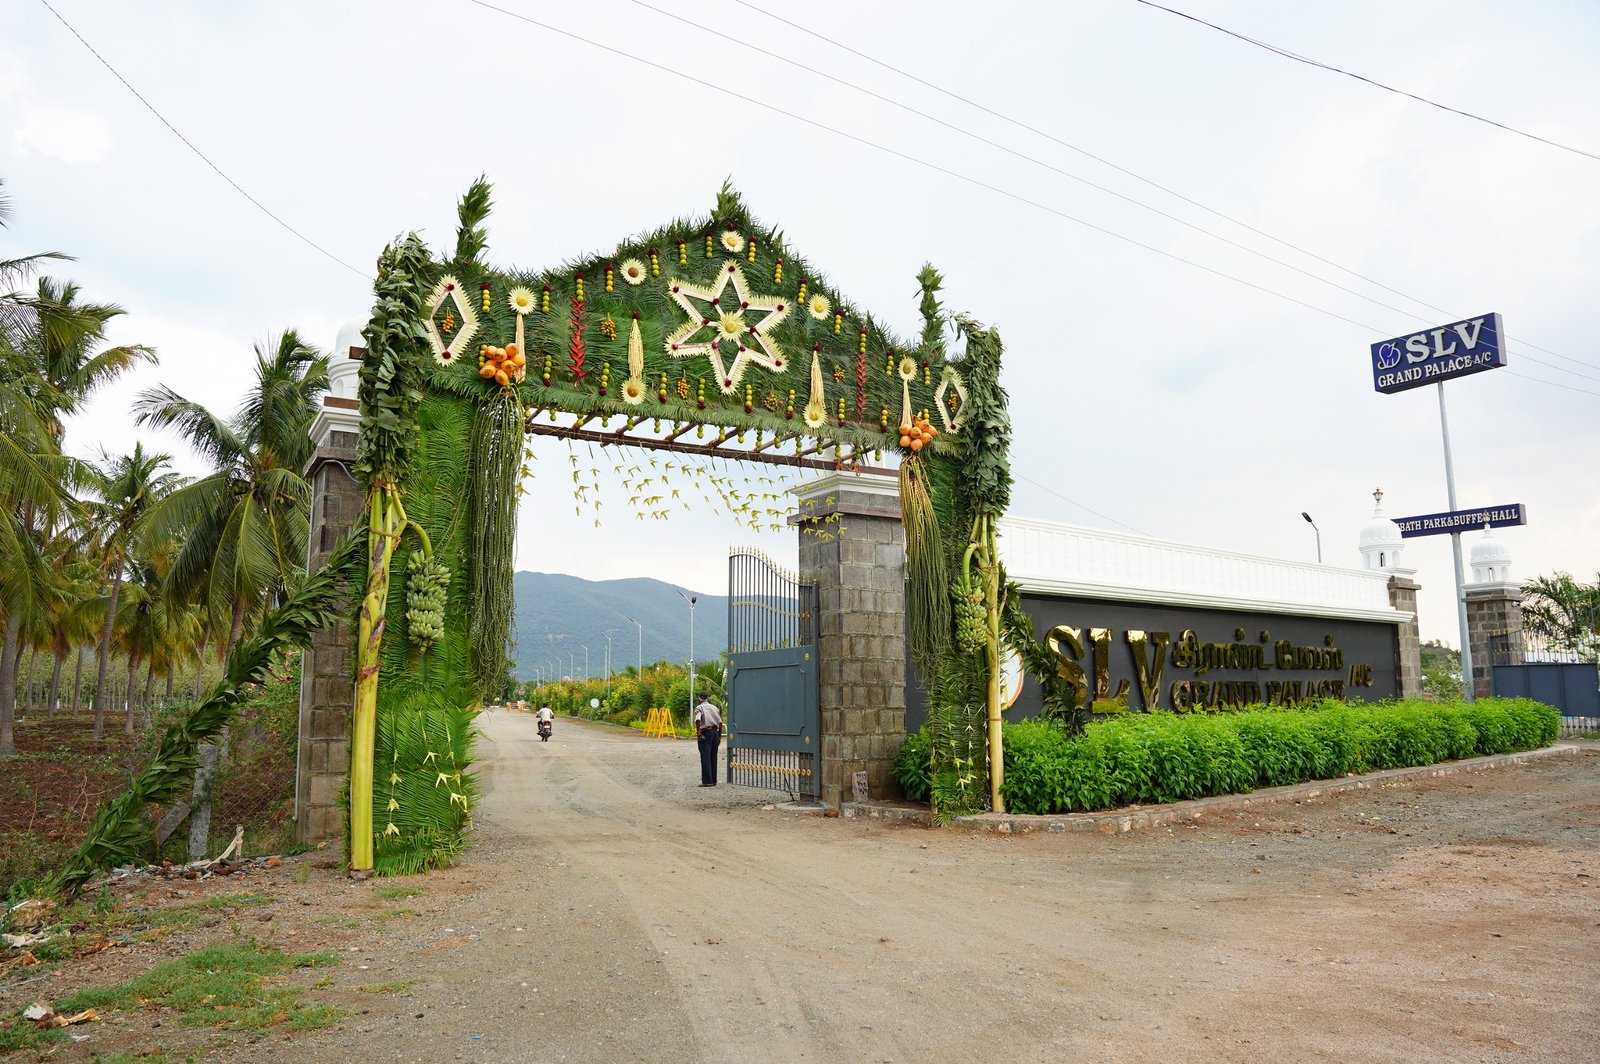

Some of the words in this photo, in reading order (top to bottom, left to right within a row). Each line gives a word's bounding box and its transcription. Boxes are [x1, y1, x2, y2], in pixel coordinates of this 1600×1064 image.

[1405, 318, 1484, 364] SLV
[1377, 367, 1422, 388] GRAND
[1425, 355, 1473, 378] PALACE
[1474, 351, 1492, 365] A/C
[1398, 520, 1421, 532] BATH
[1491, 508, 1518, 521] HALL
[1045, 625, 1170, 714] SLV
[1171, 680, 1262, 714] GRAND
